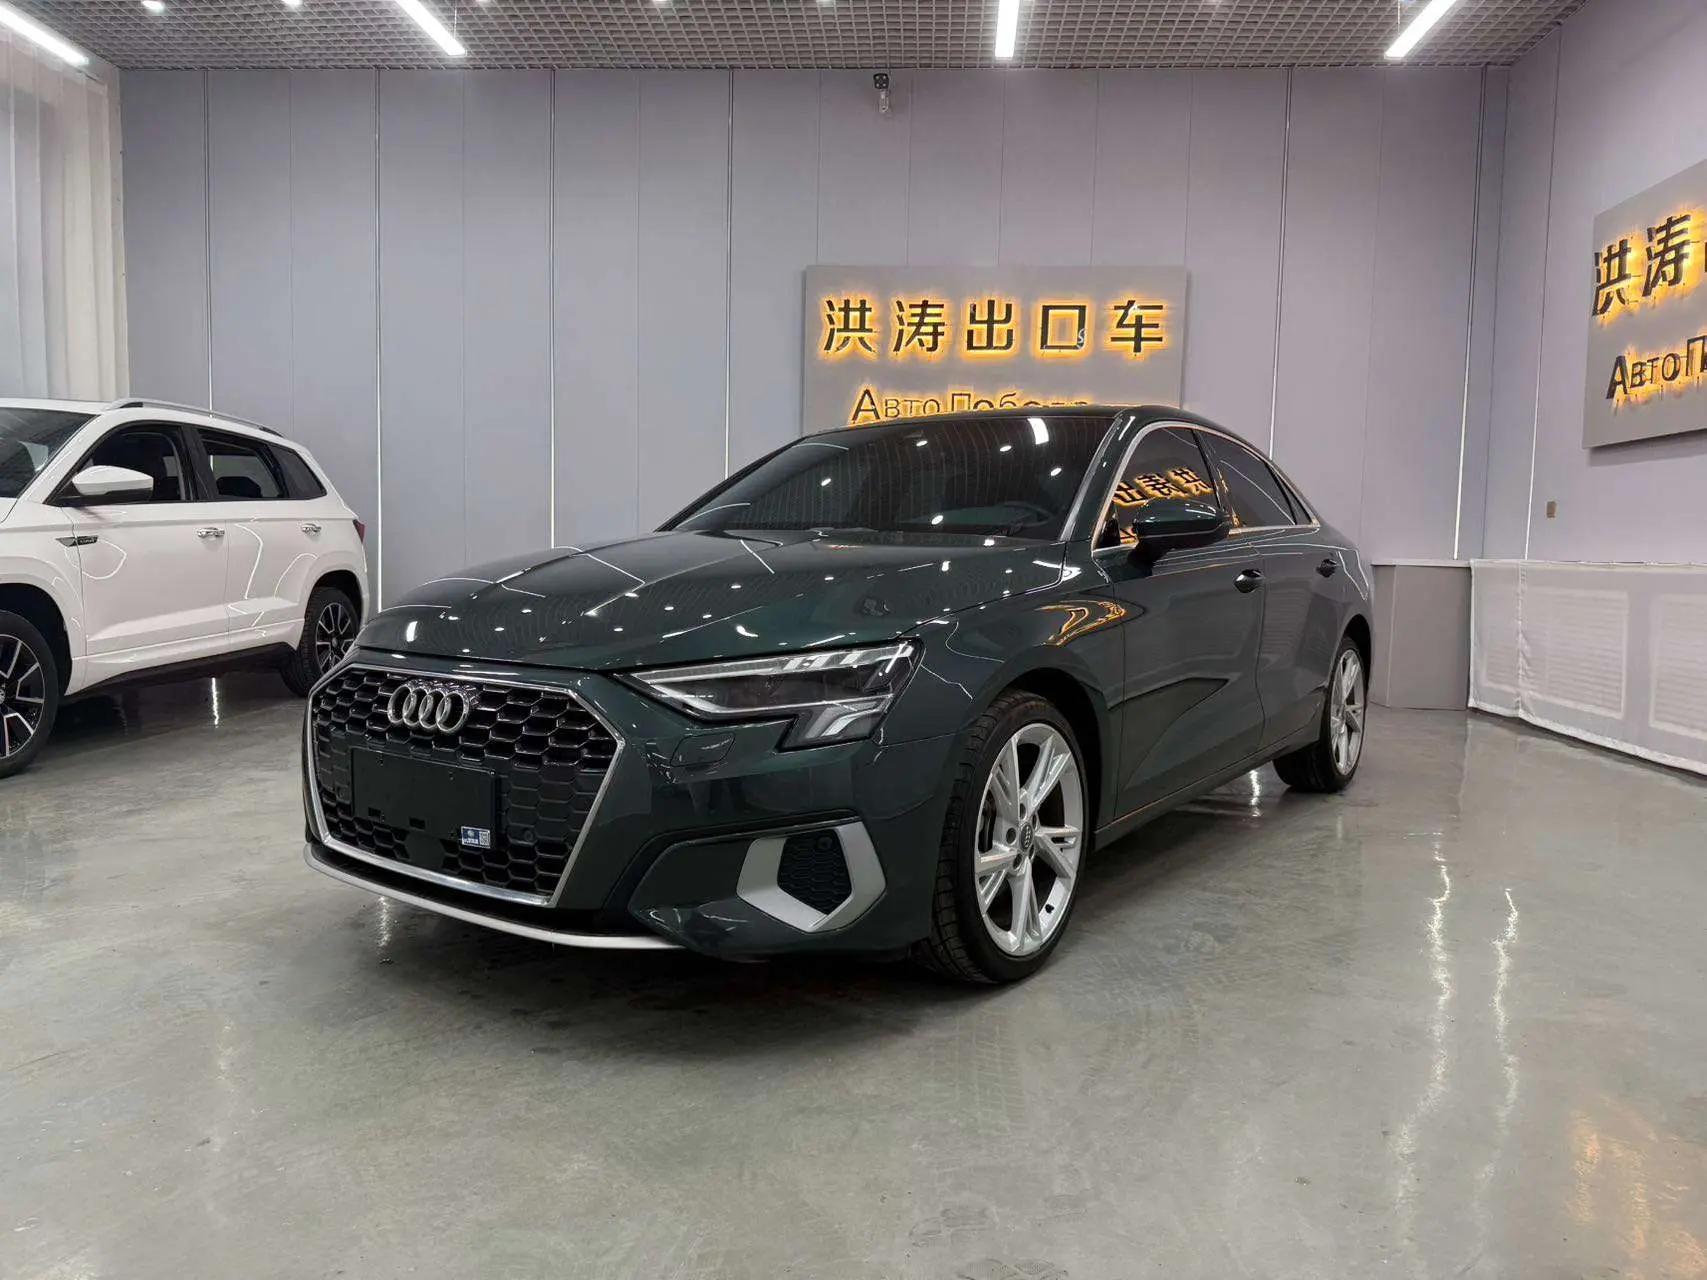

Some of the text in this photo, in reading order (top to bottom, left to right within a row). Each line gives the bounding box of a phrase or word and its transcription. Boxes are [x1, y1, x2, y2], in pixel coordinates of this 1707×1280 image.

[823, 299, 1164, 353] 洪涛出口车
